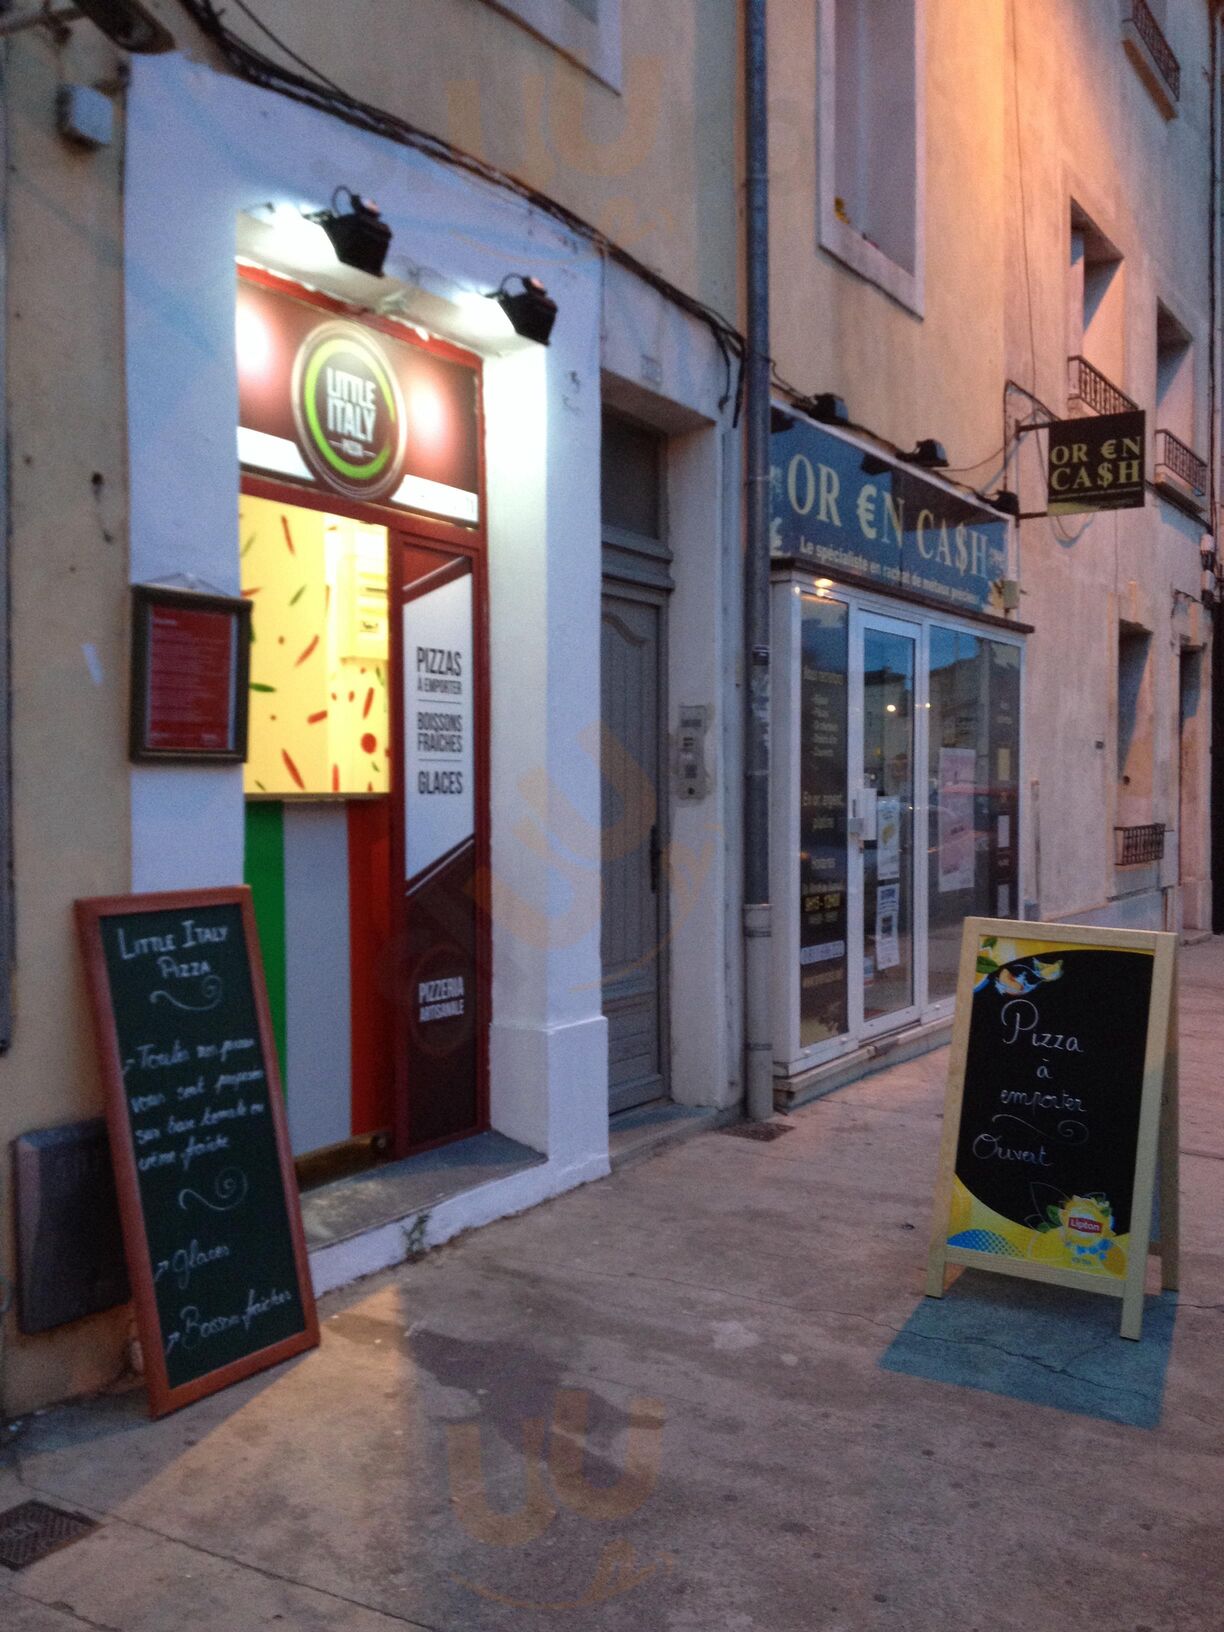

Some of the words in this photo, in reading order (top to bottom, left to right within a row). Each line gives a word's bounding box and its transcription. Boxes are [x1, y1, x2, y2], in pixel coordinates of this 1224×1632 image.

[326, 367, 377, 410] LITTLE
[327, 396, 377, 444] ITALY
[1050, 443, 1089, 465] OR
[1100, 436, 1141, 459] €N
[787, 453, 842, 527] OR
[800, 535, 814, 555] Le
[416, 646, 462, 676] PIZZAS
[417, 711, 462, 733] BOISSONS
[418, 771, 462, 795] GLACES
[1036, 1058, 1053, 1080] à
[1000, 1088, 1087, 1115] emporter
[972, 1133, 1055, 1167] Ouvert
[1070, 1218, 1100, 1232] Lipton
